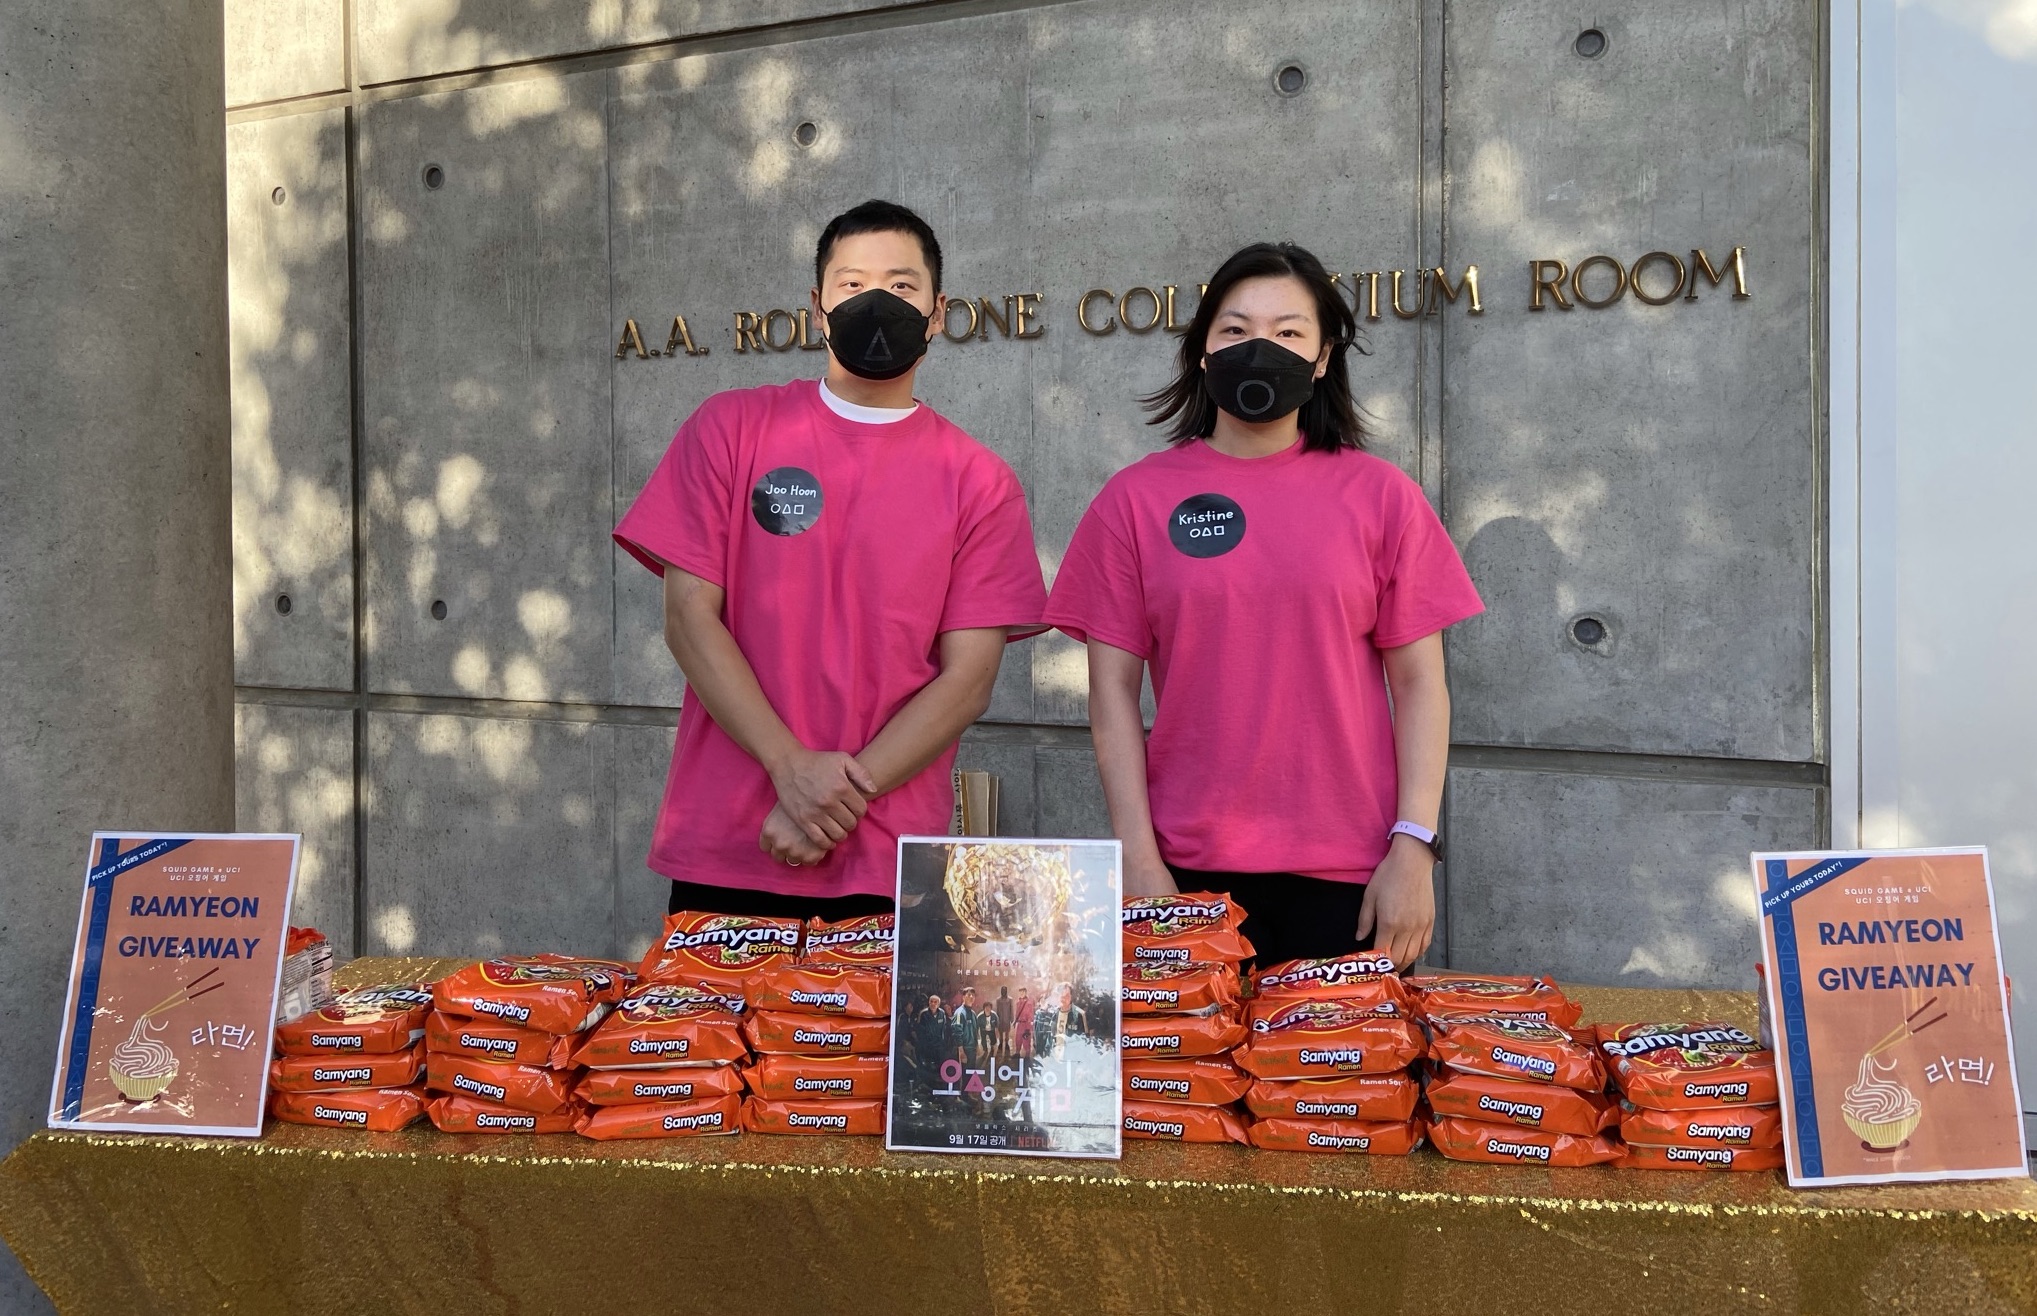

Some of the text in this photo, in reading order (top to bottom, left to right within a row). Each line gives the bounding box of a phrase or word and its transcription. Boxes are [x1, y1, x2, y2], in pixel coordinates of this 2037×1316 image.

[615, 314, 710, 358] A.A.
[1528, 246, 1752, 312] ROOM
[765, 484, 817, 499] Joo Hoon
[1178, 510, 1234, 525] Kristine
[91, 871, 107, 881] PICK
[107, 866, 116, 874] UP
[1765, 892, 1780, 908] PICK
[1780, 888, 1790, 898] UP
[1790, 877, 1814, 893] YOURS
[129, 895, 260, 918] RAMYEON
[1122, 903, 1227, 920] amyang
[666, 926, 798, 950] Samyang
[1818, 918, 1964, 946] RAMYEON
[118, 936, 261, 959] GIVEAWAY
[1135, 947, 1189, 960] Samyang
[1818, 963, 1975, 991] GIVEAWAY
[790, 990, 847, 1006] Samyang
[1122, 988, 1178, 1003] Samyang
[474, 998, 530, 1020] Samyang
[191, 1020, 255, 1050] 라면!
[312, 1034, 361, 1048] Samyang
[461, 1034, 517, 1051] Samyang
[793, 1030, 851, 1046] Samyang
[1122, 1035, 1179, 1049] Samyang
[1603, 1028, 1755, 1056] Samyang
[630, 1039, 688, 1054] Samyang
[1300, 1049, 1360, 1066] Samyang
[1492, 1047, 1555, 1073] Samyang
[314, 1068, 370, 1082] Samyang
[1924, 1055, 1995, 1085] 라면!
[454, 1074, 505, 1098] Samyang
[795, 1078, 852, 1091] Samyang
[932, 1057, 1024, 1102] 오징어
[1130, 1076, 1189, 1092] Samyang
[634, 1084, 691, 1097] Samyang
[1685, 1083, 1748, 1097] Samyang
[314, 1106, 366, 1123] Samyang
[1296, 1101, 1357, 1116] Samyang
[1479, 1096, 1542, 1118] Samyang
[477, 1113, 534, 1129] Samyang
[663, 1112, 722, 1129] Samyang
[788, 1113, 846, 1127] Samyang
[1124, 1117, 1183, 1135] Samyang
[1688, 1124, 1751, 1139] Samyang
[949, 1134, 1007, 1146] 9월 17일 공개
[1308, 1132, 1369, 1148] Samyang
[1487, 1139, 1550, 1158] Samyang
[1667, 1147, 1732, 1163] Samyang
